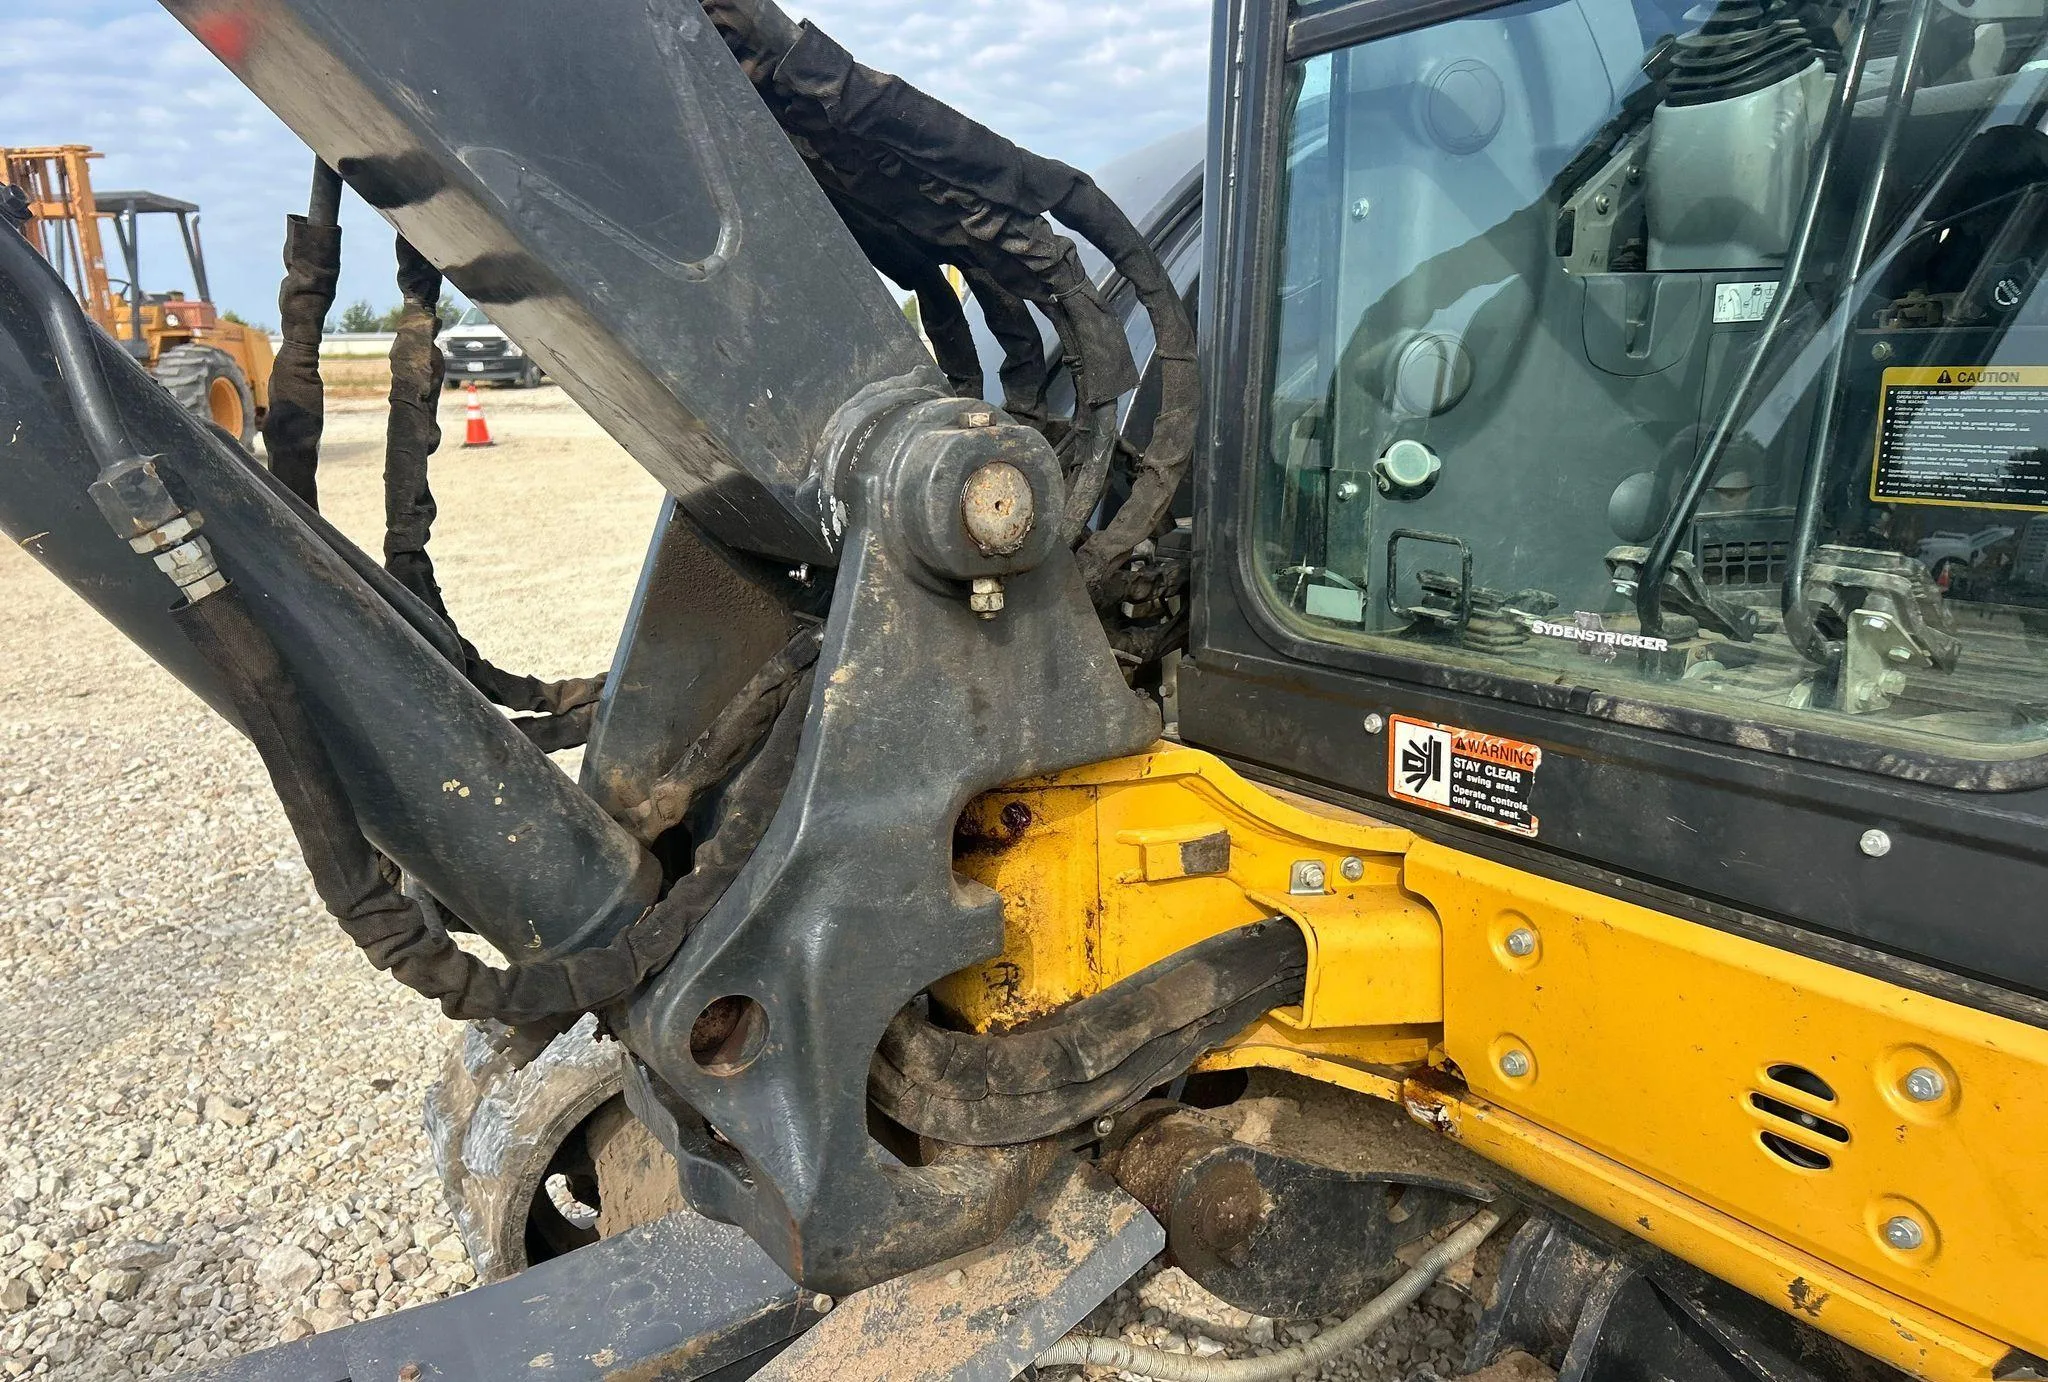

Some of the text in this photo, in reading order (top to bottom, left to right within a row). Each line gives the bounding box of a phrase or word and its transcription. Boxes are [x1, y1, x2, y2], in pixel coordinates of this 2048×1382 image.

[1957, 372, 2020, 383] CAUTION
[1531, 620, 1668, 652] SYDENSTRICKER
[1468, 740, 1534, 768] WARNING
[1453, 771, 1518, 794] of swing area.
[1454, 758, 1520, 783] STAY CLEAR
[1452, 795, 1520, 820] only from seat.
[1453, 784, 1528, 812] Operate controls
